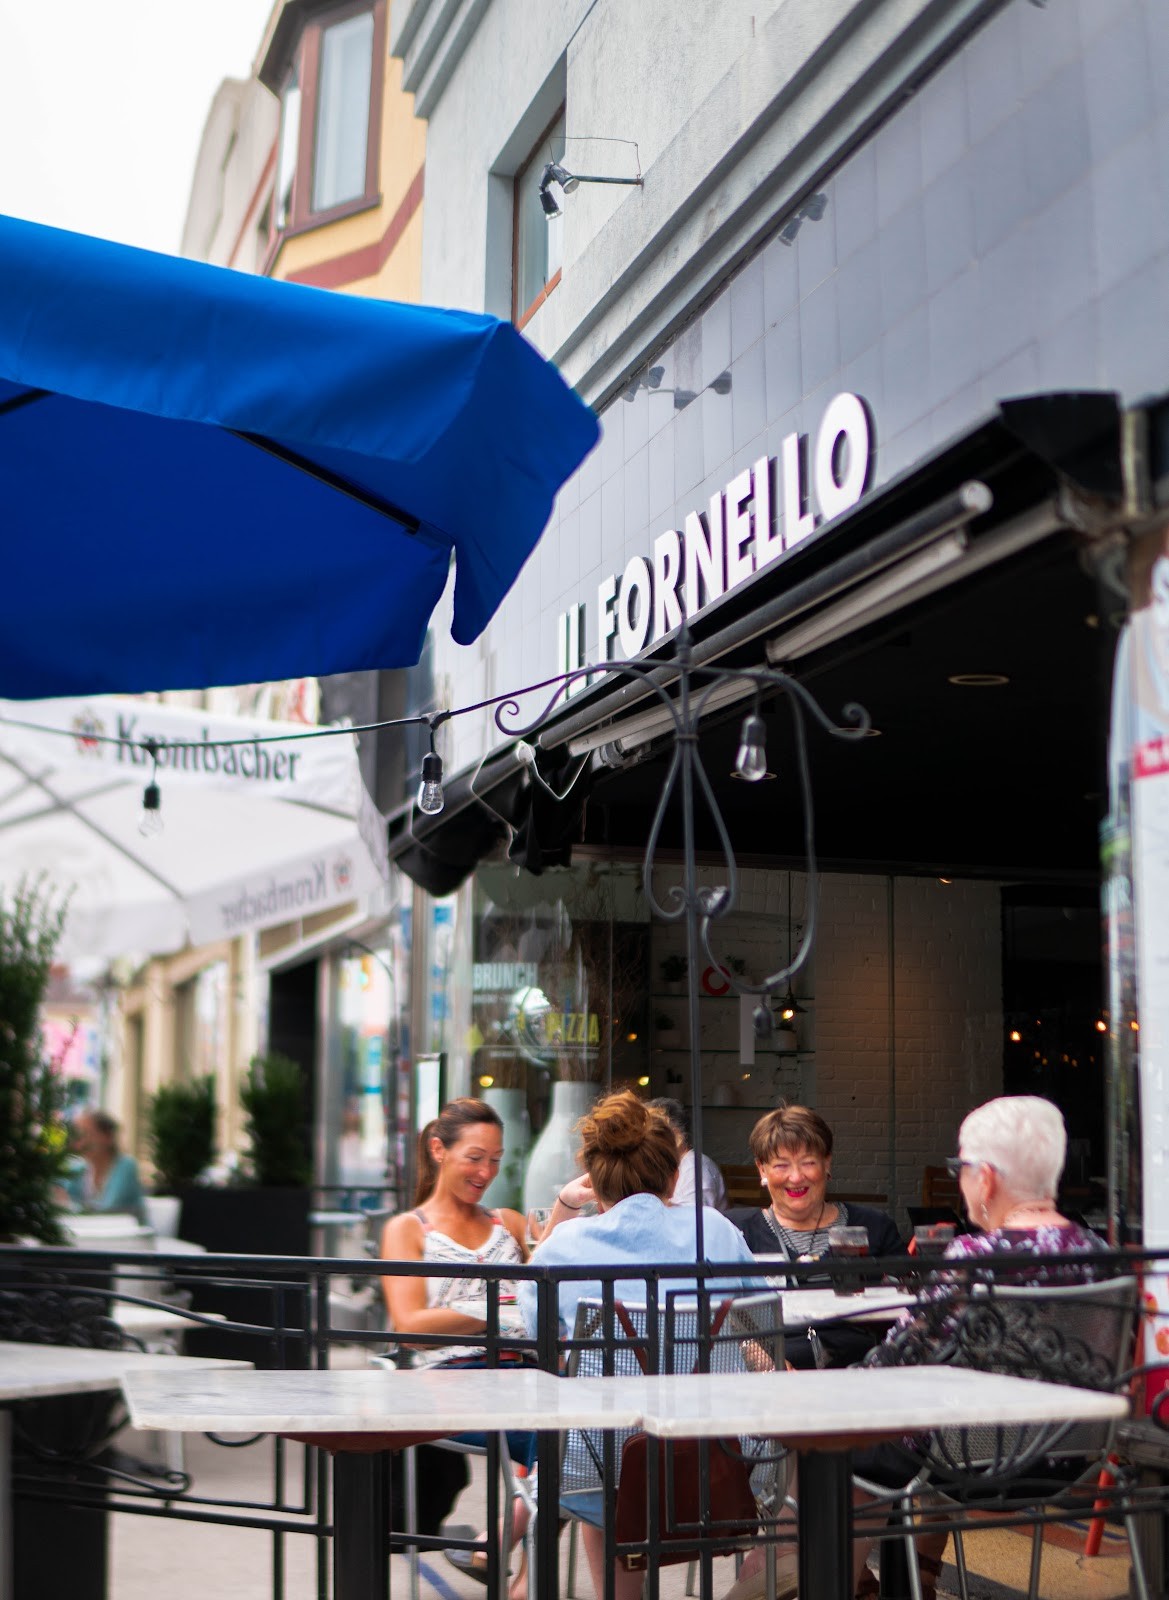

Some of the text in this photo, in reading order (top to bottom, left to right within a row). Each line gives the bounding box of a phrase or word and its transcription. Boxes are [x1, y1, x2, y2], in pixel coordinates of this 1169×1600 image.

[558, 391, 874, 706] IL FORNELLO
[116, 712, 302, 782] Krombacher
[473, 963, 538, 990] BRUNCH
[546, 1012, 600, 1043] PIZZA
